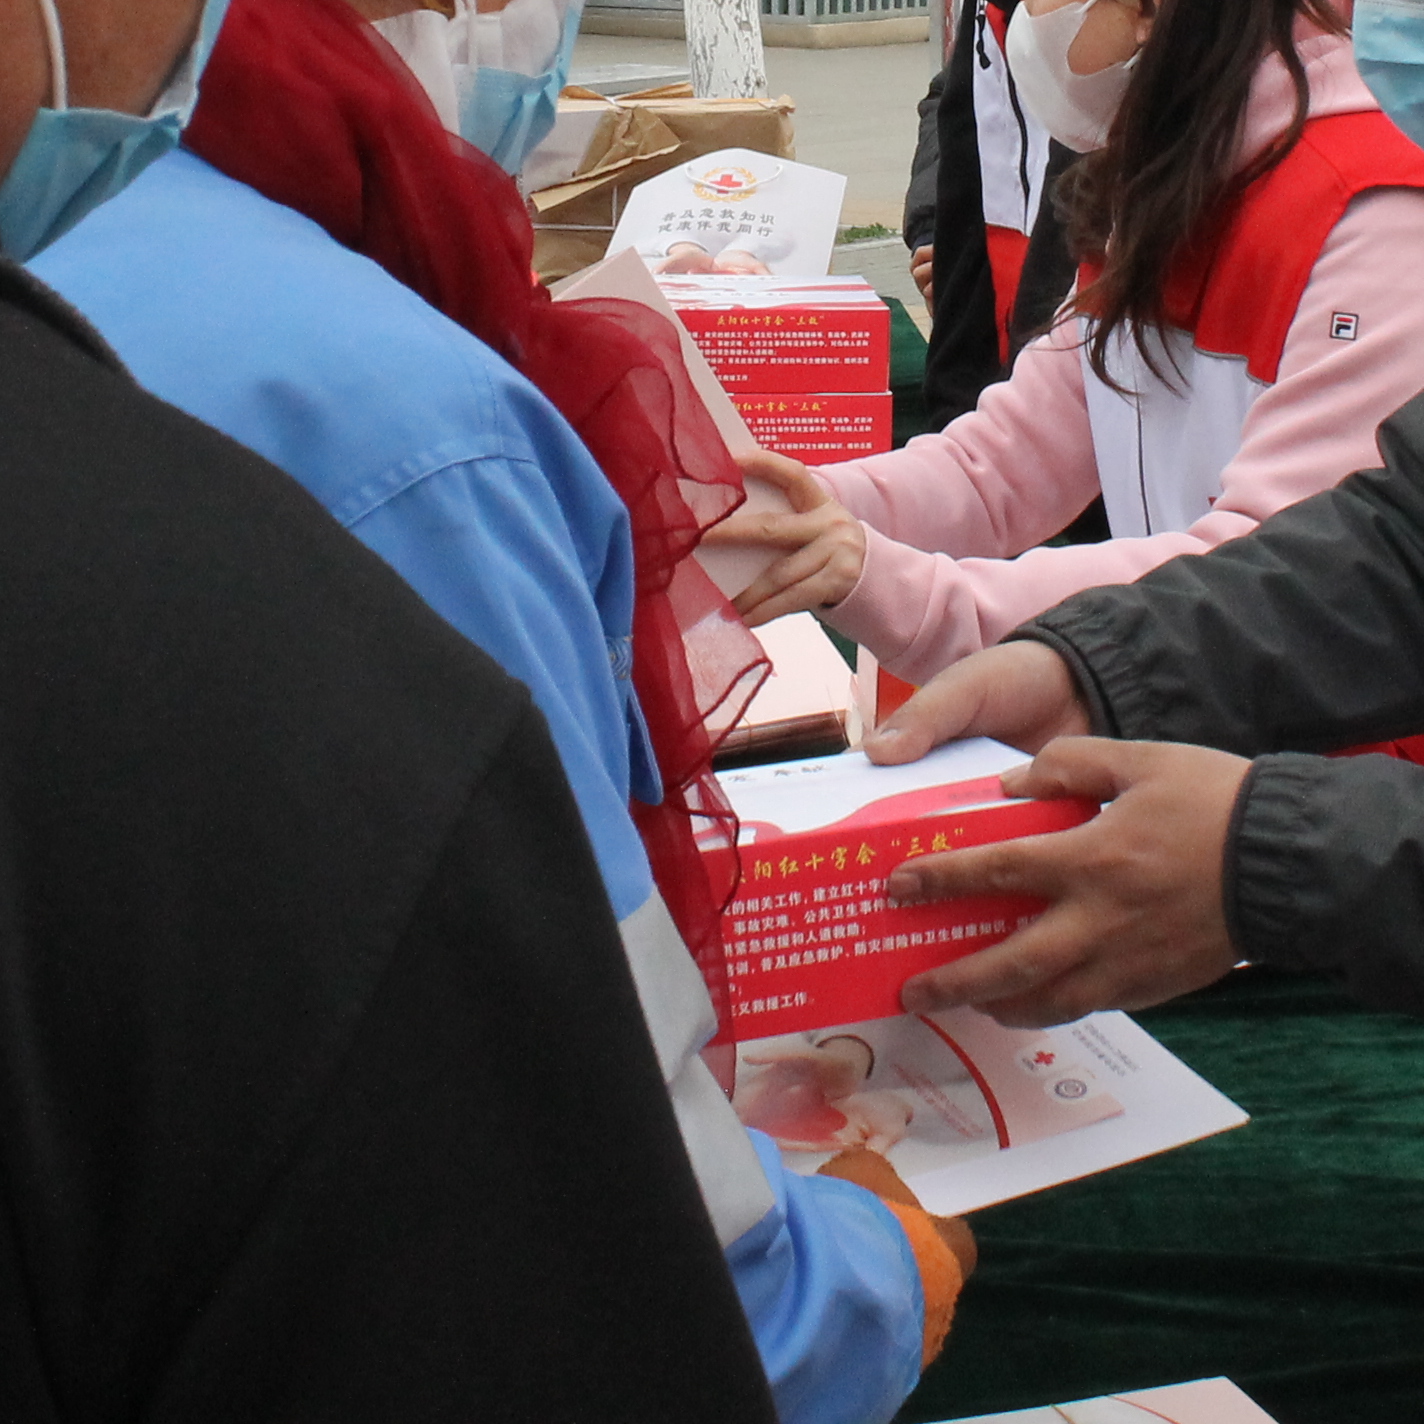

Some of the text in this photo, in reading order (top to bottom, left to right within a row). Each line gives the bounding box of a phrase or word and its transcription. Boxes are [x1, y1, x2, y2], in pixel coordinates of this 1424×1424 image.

[662, 208, 775, 225] 普及急救知识
[658, 220, 773, 237] 健康伴我同行
